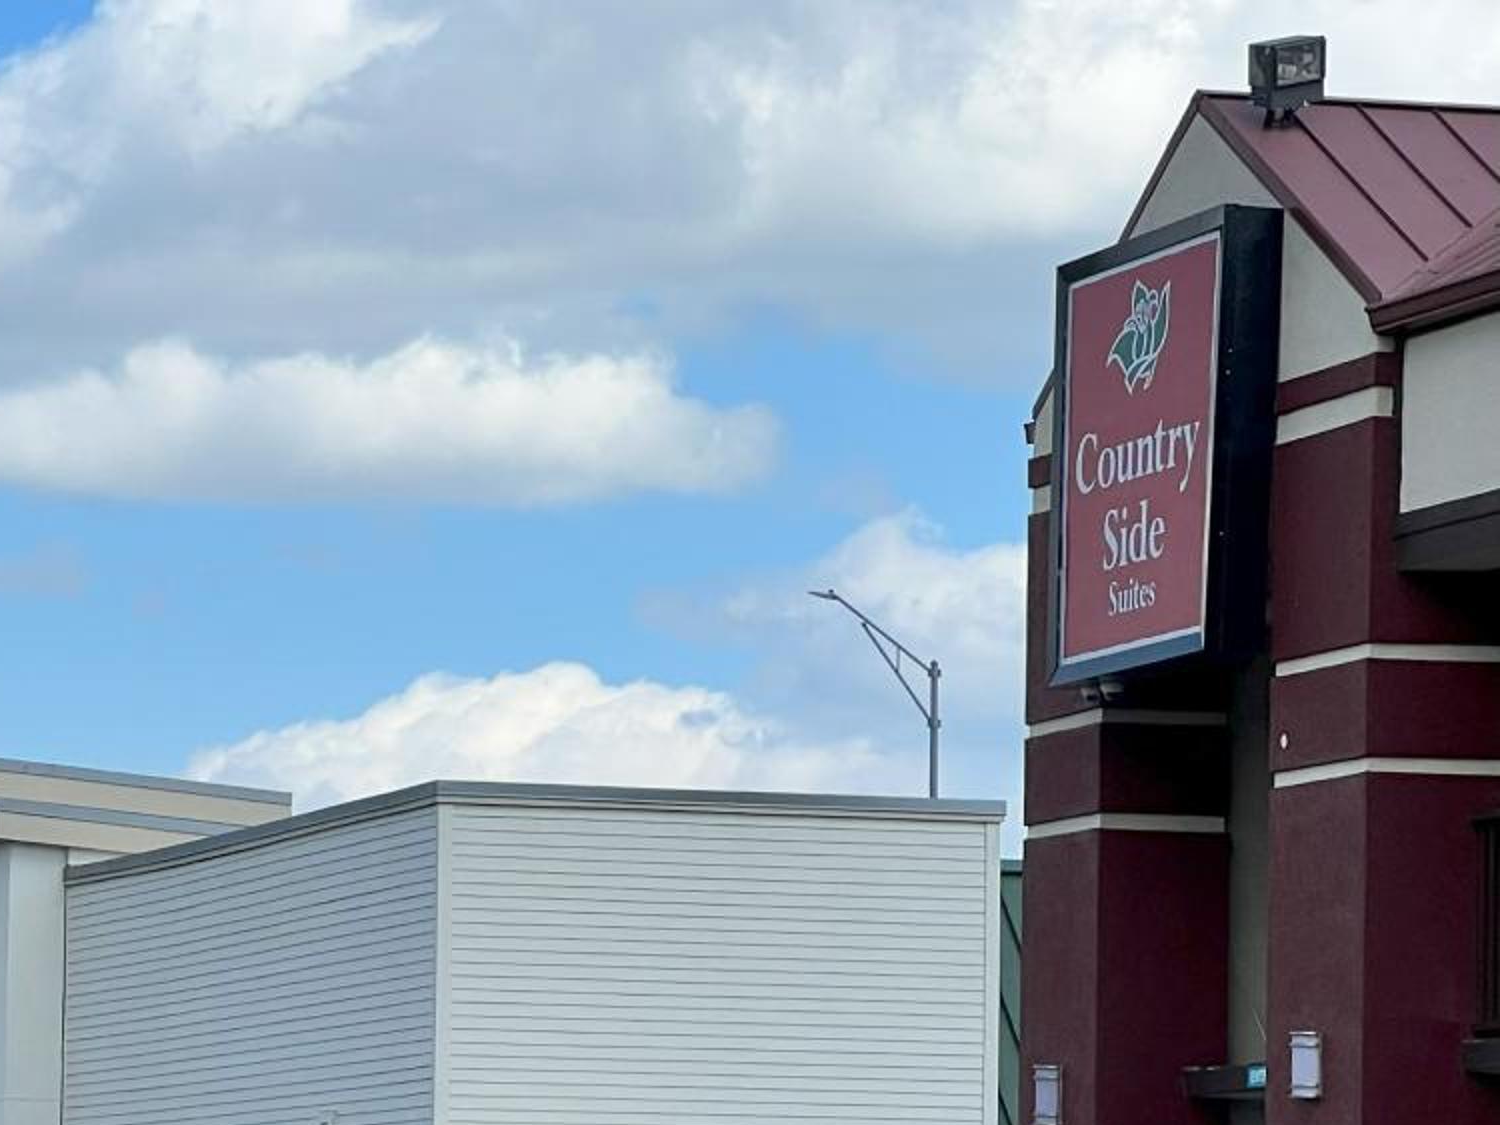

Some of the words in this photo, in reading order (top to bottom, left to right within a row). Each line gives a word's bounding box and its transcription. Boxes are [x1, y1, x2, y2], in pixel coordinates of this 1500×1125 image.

[1076, 419, 1200, 494] Country
[1102, 498, 1166, 571] Side
[1108, 579, 1156, 616] Suites
